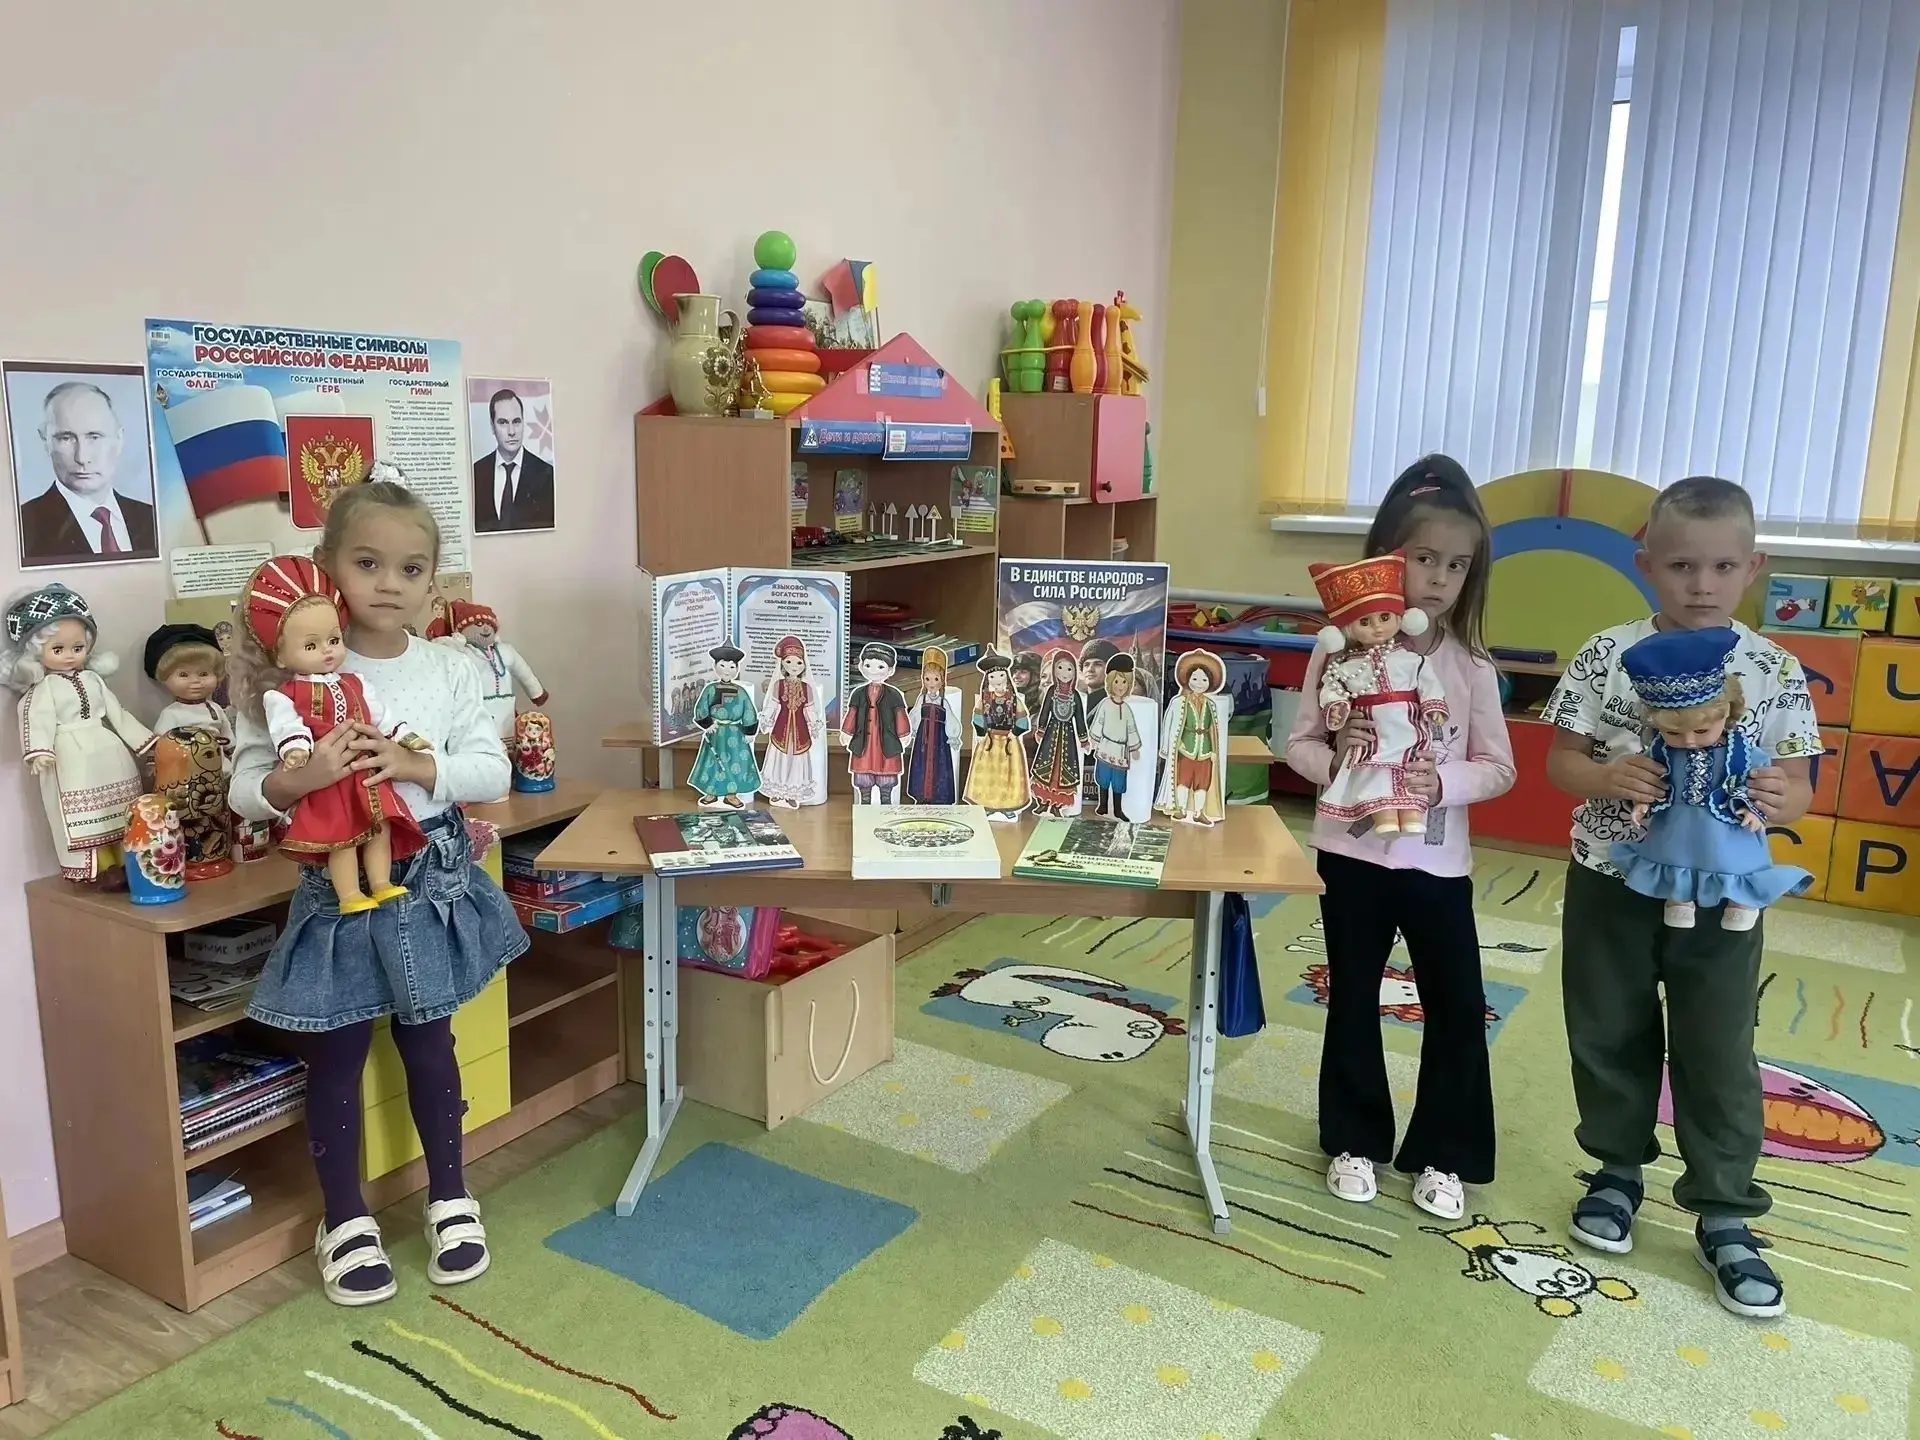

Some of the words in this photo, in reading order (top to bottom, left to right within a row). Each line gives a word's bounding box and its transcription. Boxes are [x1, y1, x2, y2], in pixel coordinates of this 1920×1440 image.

[193, 326, 353, 350] ГОСУДАРСТВЕННЫЕ
[355, 337, 428, 355] СИМВОЛЫ
[195, 344, 326, 368] РОССИЙСКОЙ
[328, 353, 430, 374] ФЕДЕРАЦИИ
[157, 369, 243, 380] ГОСУДАРСТВЕННЫЙ
[290, 375, 365, 385] ГОСУДАРСТВЕННЫЙ
[186, 379, 217, 390] ФЛАГ
[316, 384, 341, 394] ГЕРБ
[388, 378, 450, 388] ГОСУДАРСТВЕННЫЙ
[410, 387, 433, 396] ГИМН
[1010, 566, 1021, 582] В
[1023, 569, 1085, 584] ЕДИНСТВЕ
[1088, 571, 1144, 586] НАРОДОВ
[1033, 585, 1066, 599] СИЛА
[1070, 585, 1126, 600] РОССИИ!
[1831, 604, 1860, 625] Ж
[1604, 694, 1642, 721] RUL
